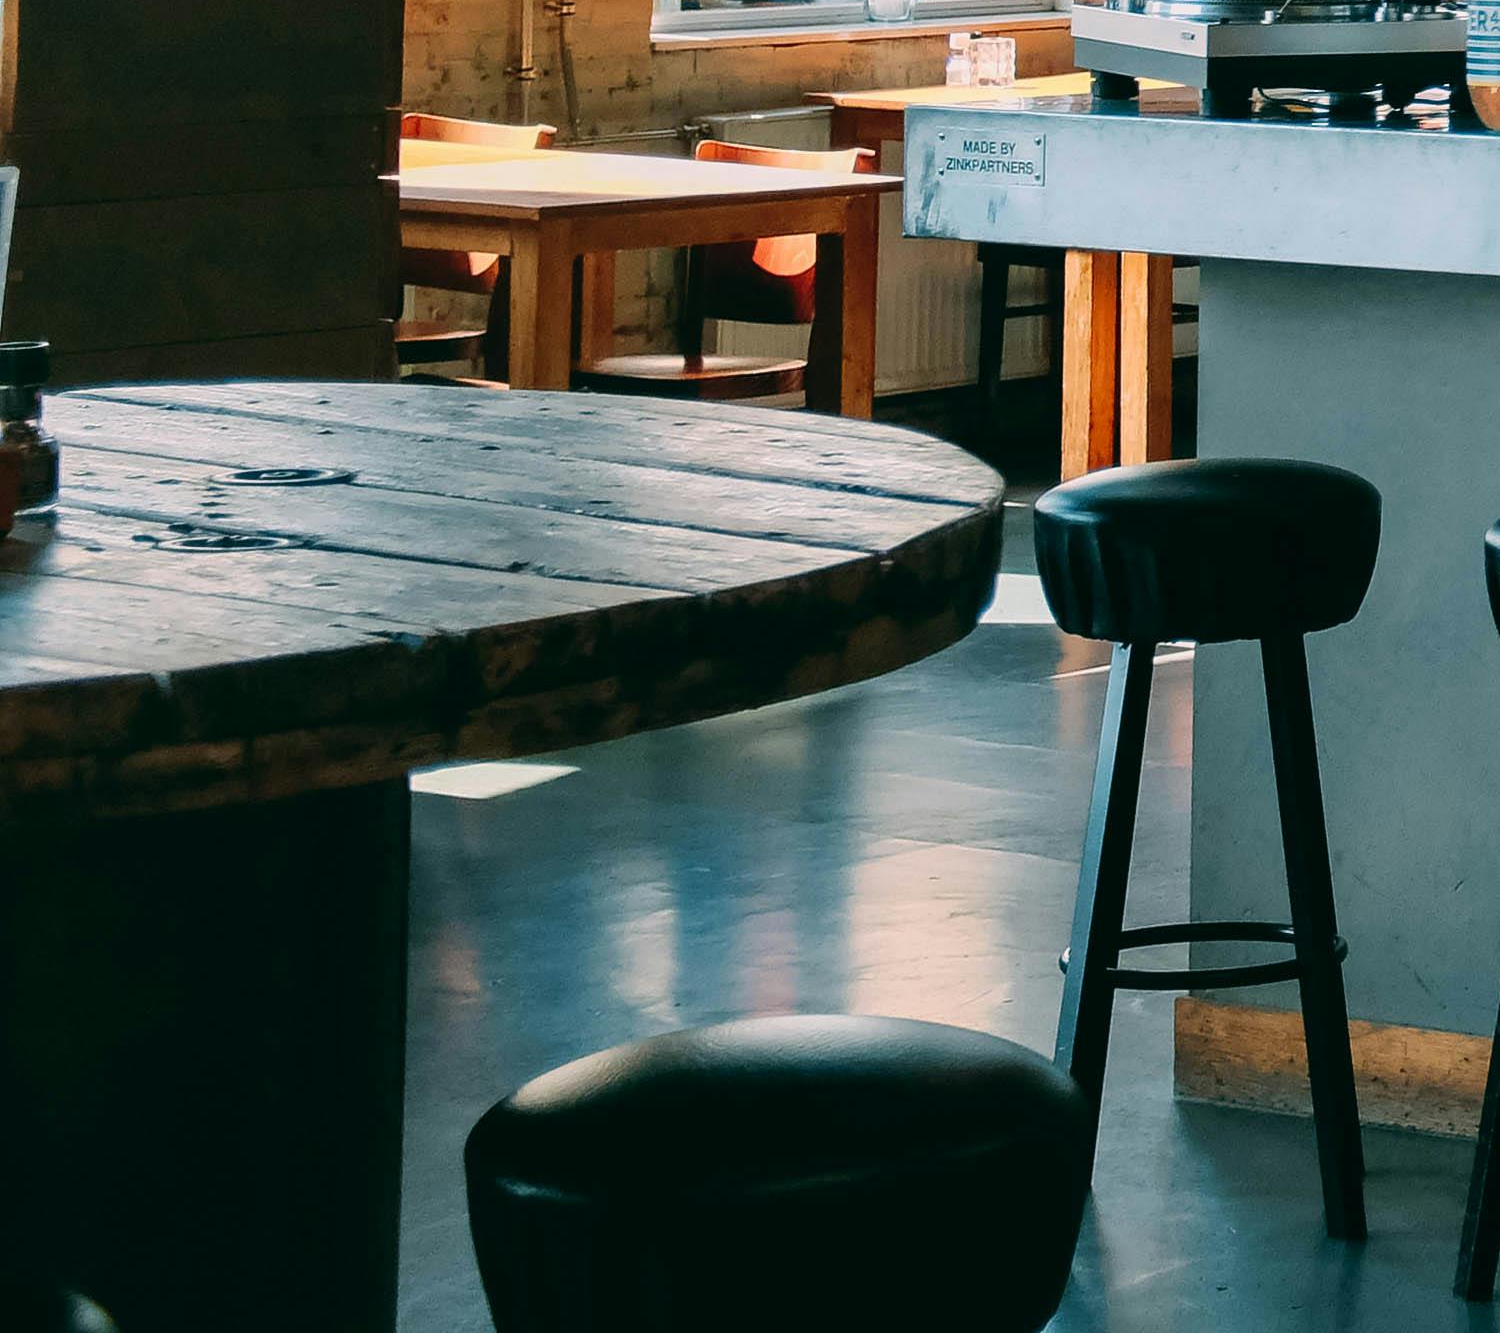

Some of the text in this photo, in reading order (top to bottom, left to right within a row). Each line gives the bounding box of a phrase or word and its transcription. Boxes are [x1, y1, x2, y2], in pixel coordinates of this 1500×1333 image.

[963, 139, 1017, 157] MADE BY
[945, 157, 1035, 176] ZINKPARTNERS
